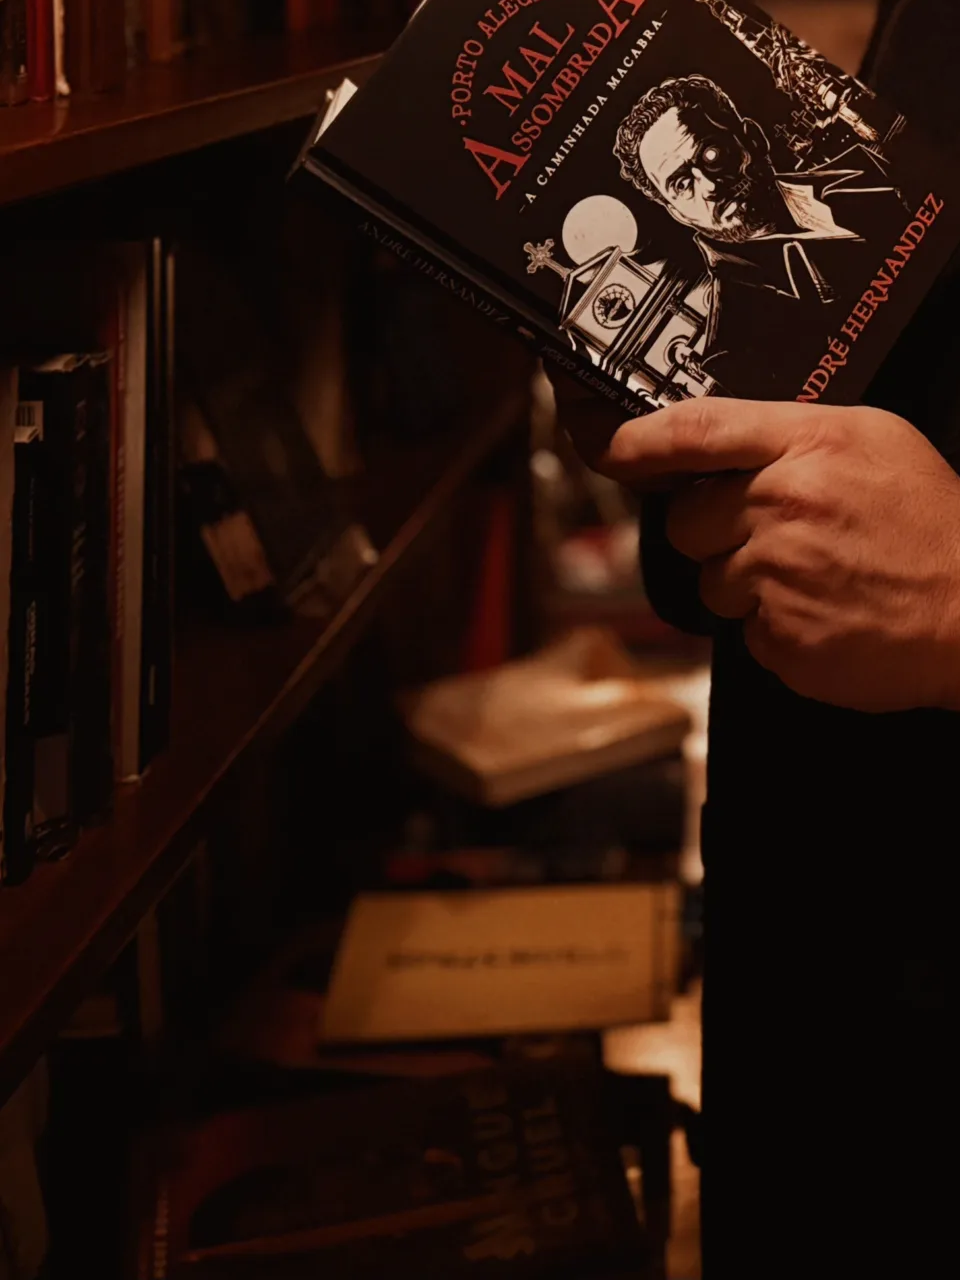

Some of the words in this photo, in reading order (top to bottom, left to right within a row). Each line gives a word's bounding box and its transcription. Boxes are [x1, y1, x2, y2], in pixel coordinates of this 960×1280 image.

[450, 39, 485, 119] PORTO
[482, 20, 576, 118] MAL
[524, 191, 537, 204] A
[536, 94, 609, 187] CAMINHADA
[606, 19, 664, 91] MACABRA
[796, 335, 850, 404] NDRÉ
[840, 191, 945, 342] HERNANDEZ
[620, 397, 648, 417] MA
